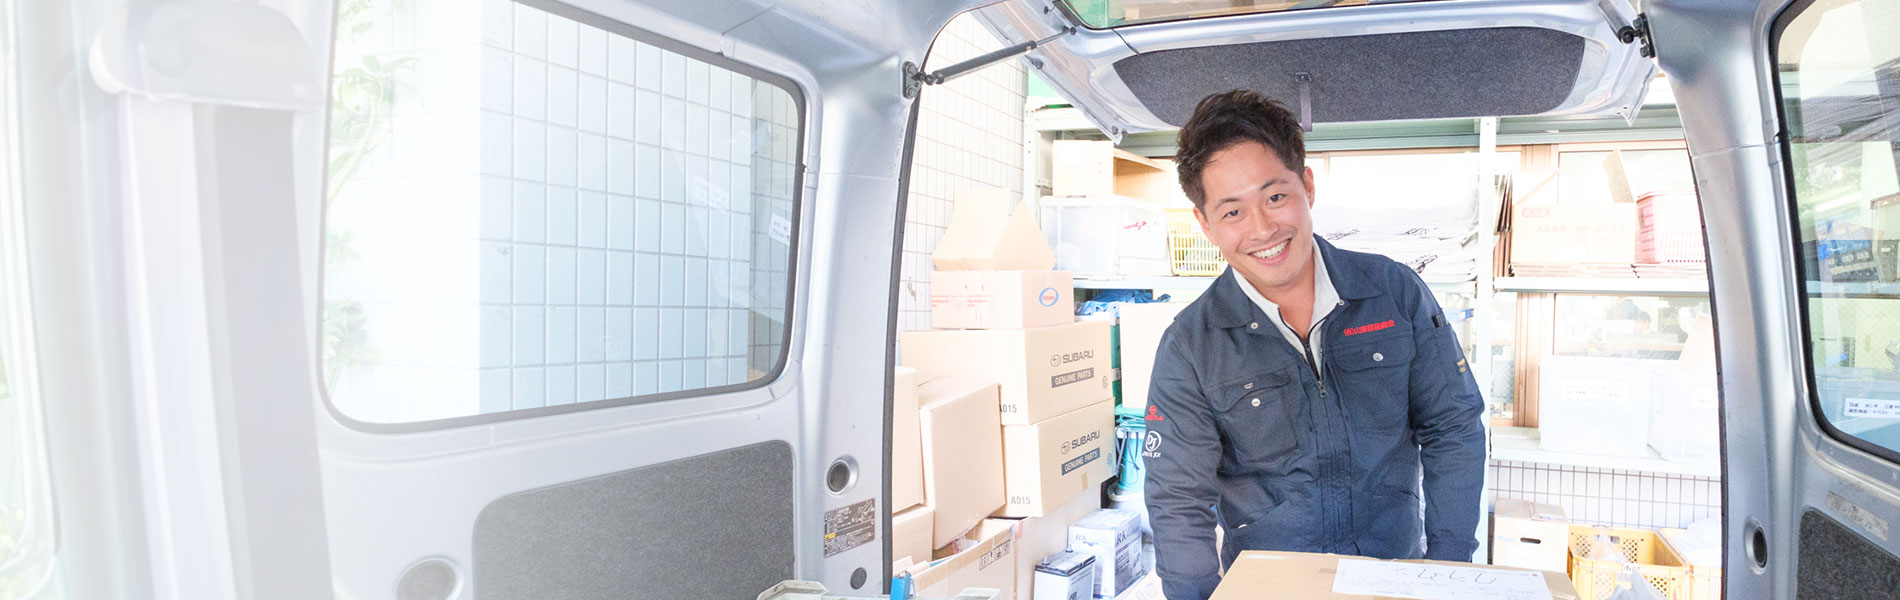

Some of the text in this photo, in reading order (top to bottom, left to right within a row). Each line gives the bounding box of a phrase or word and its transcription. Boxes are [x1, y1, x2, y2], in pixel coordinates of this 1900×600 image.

[1062, 349, 1094, 364] SUBARU
[1055, 370, 1091, 386] GENUINE PARTS
[1071, 429, 1100, 449] SUBARU
[1064, 450, 1098, 472] GENUINE PARTS
[1010, 496, 1031, 505] A015
